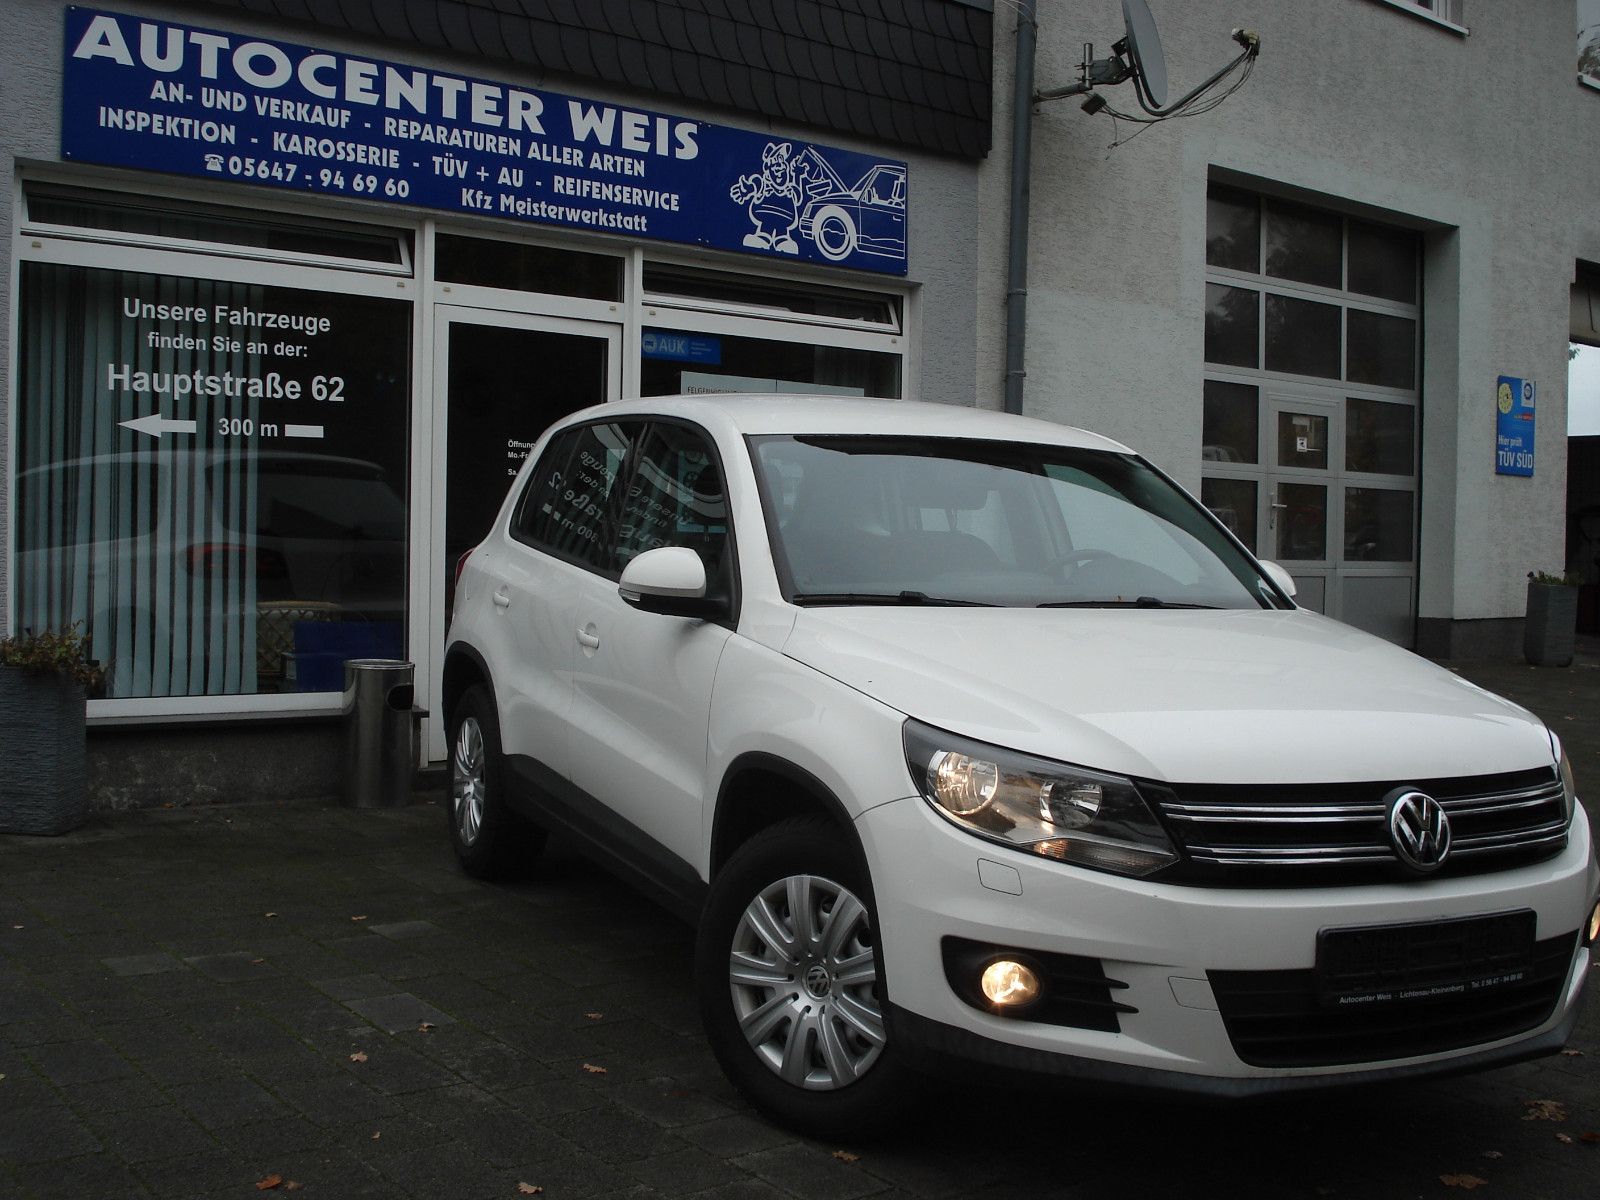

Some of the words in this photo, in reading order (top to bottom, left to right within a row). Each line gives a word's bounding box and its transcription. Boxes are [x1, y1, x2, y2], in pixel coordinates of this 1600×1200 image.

[72, 15, 546, 135] AUTOCENTER
[568, 100, 699, 160] WEIS
[150, 80, 193, 103] AN-
[201, 87, 247, 112] UND
[254, 95, 351, 129] VERKAUF
[384, 117, 522, 157] REPARATUREN
[527, 142, 585, 168] ALLER
[589, 150, 646, 178] ARTEN
[99, 106, 236, 146] INSPEKTION
[273, 131, 400, 169] KAROSSERIE
[432, 153, 468, 179] TÜV
[476, 166, 490, 182] +
[497, 166, 524, 188] AU
[553, 175, 680, 212] REIFENSERVICE
[228, 155, 297, 182] 05647
[320, 168, 345, 189] 94
[352, 172, 378, 193] 69
[384, 178, 410, 199] 60
[461, 187, 493, 210] Kfz
[499, 193, 648, 232] Meisterwerkstatt
[123, 297, 207, 323] Unsere
[215, 305, 331, 336] Fahrzeuge
[148, 331, 206, 351] finden
[213, 338, 241, 353] Sie
[246, 341, 268, 355] an
[273, 341, 308, 358] der:
[108, 363, 302, 400] Hauptstraße
[311, 375, 345, 402] 62
[218, 418, 254, 437] 300
[260, 423, 278, 437] m
[1498, 447, 1516, 467] TÜV
[1516, 449, 1533, 469] SÜD
[1338, 994, 1376, 1004] Autocenter
